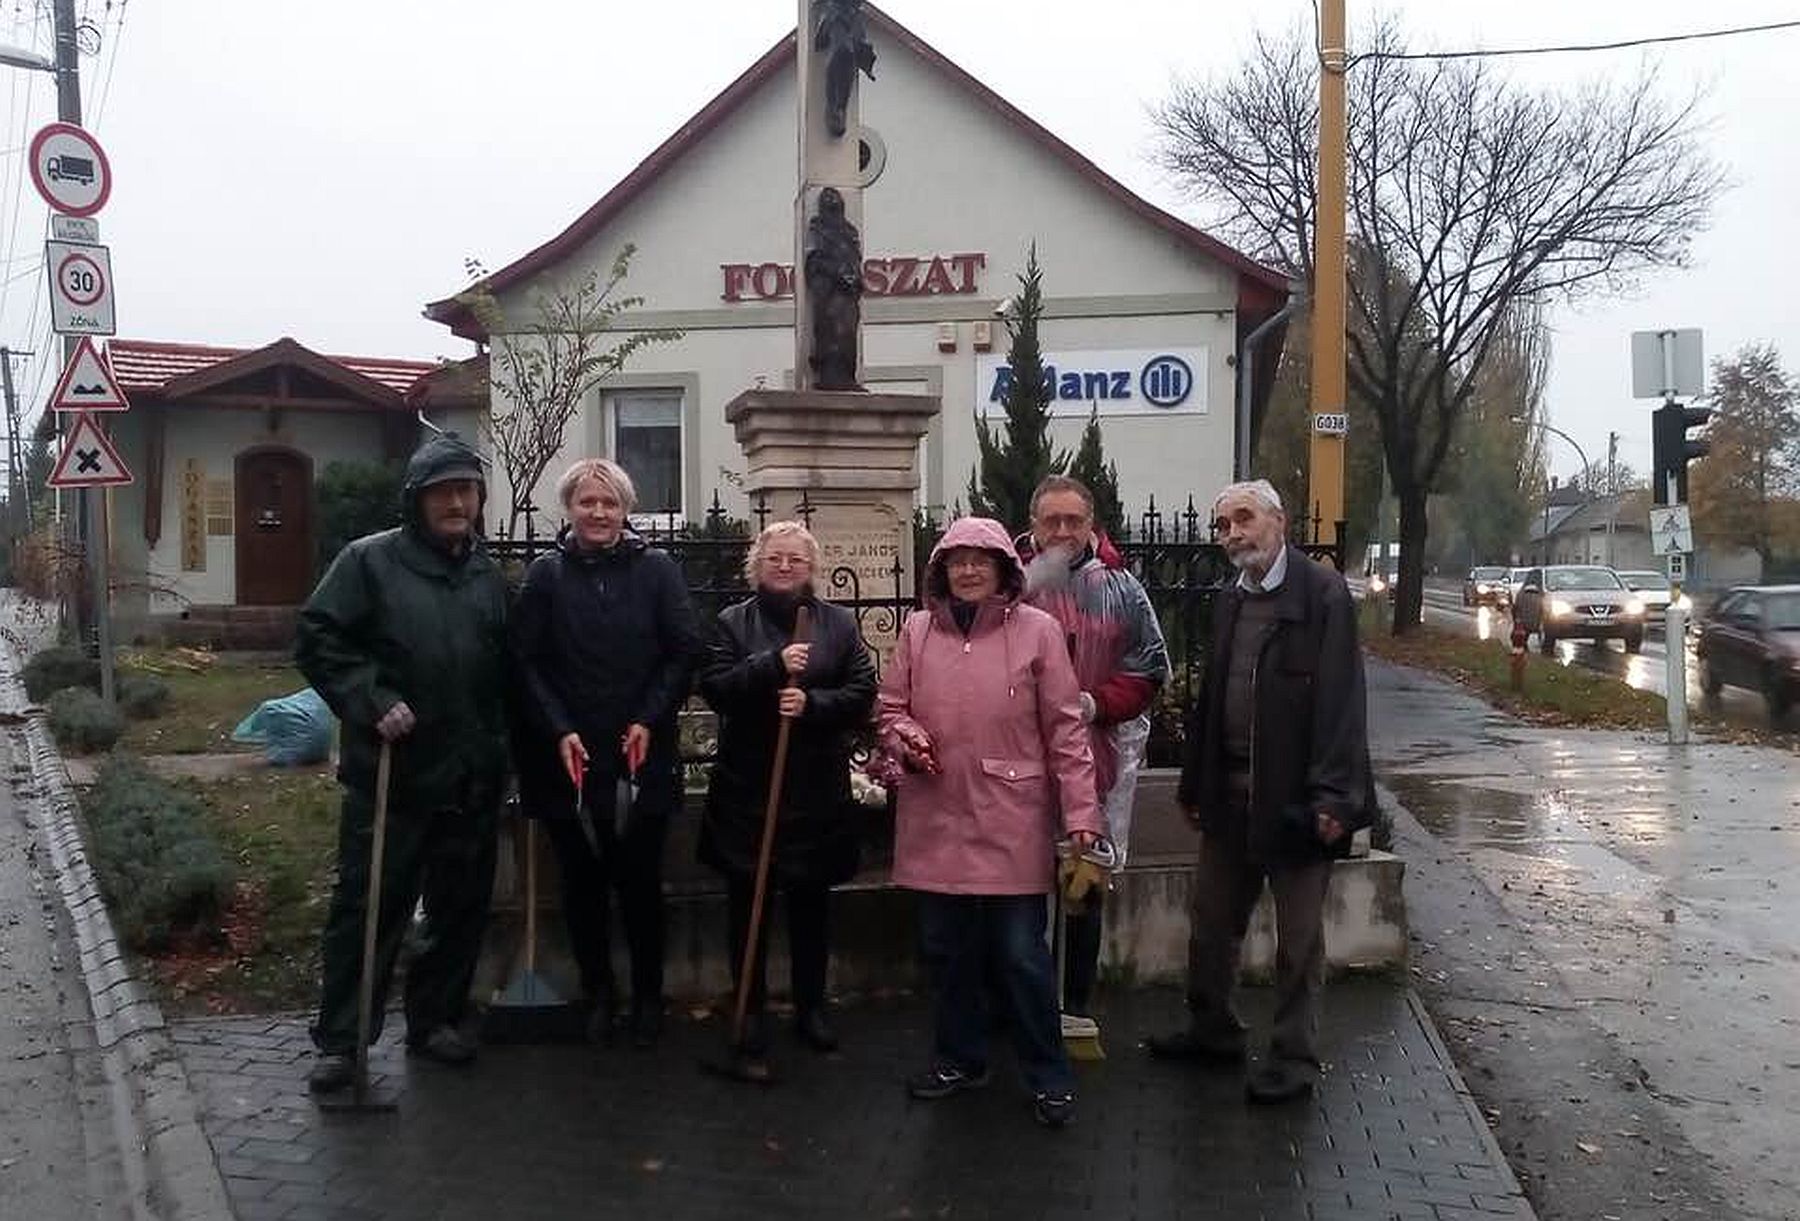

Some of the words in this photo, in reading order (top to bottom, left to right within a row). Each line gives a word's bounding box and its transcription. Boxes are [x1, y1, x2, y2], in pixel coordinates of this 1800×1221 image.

[70, 270, 94, 293] 30
[720, 253, 986, 302] FOSZAT
[990, 365, 1131, 401] Aianz
